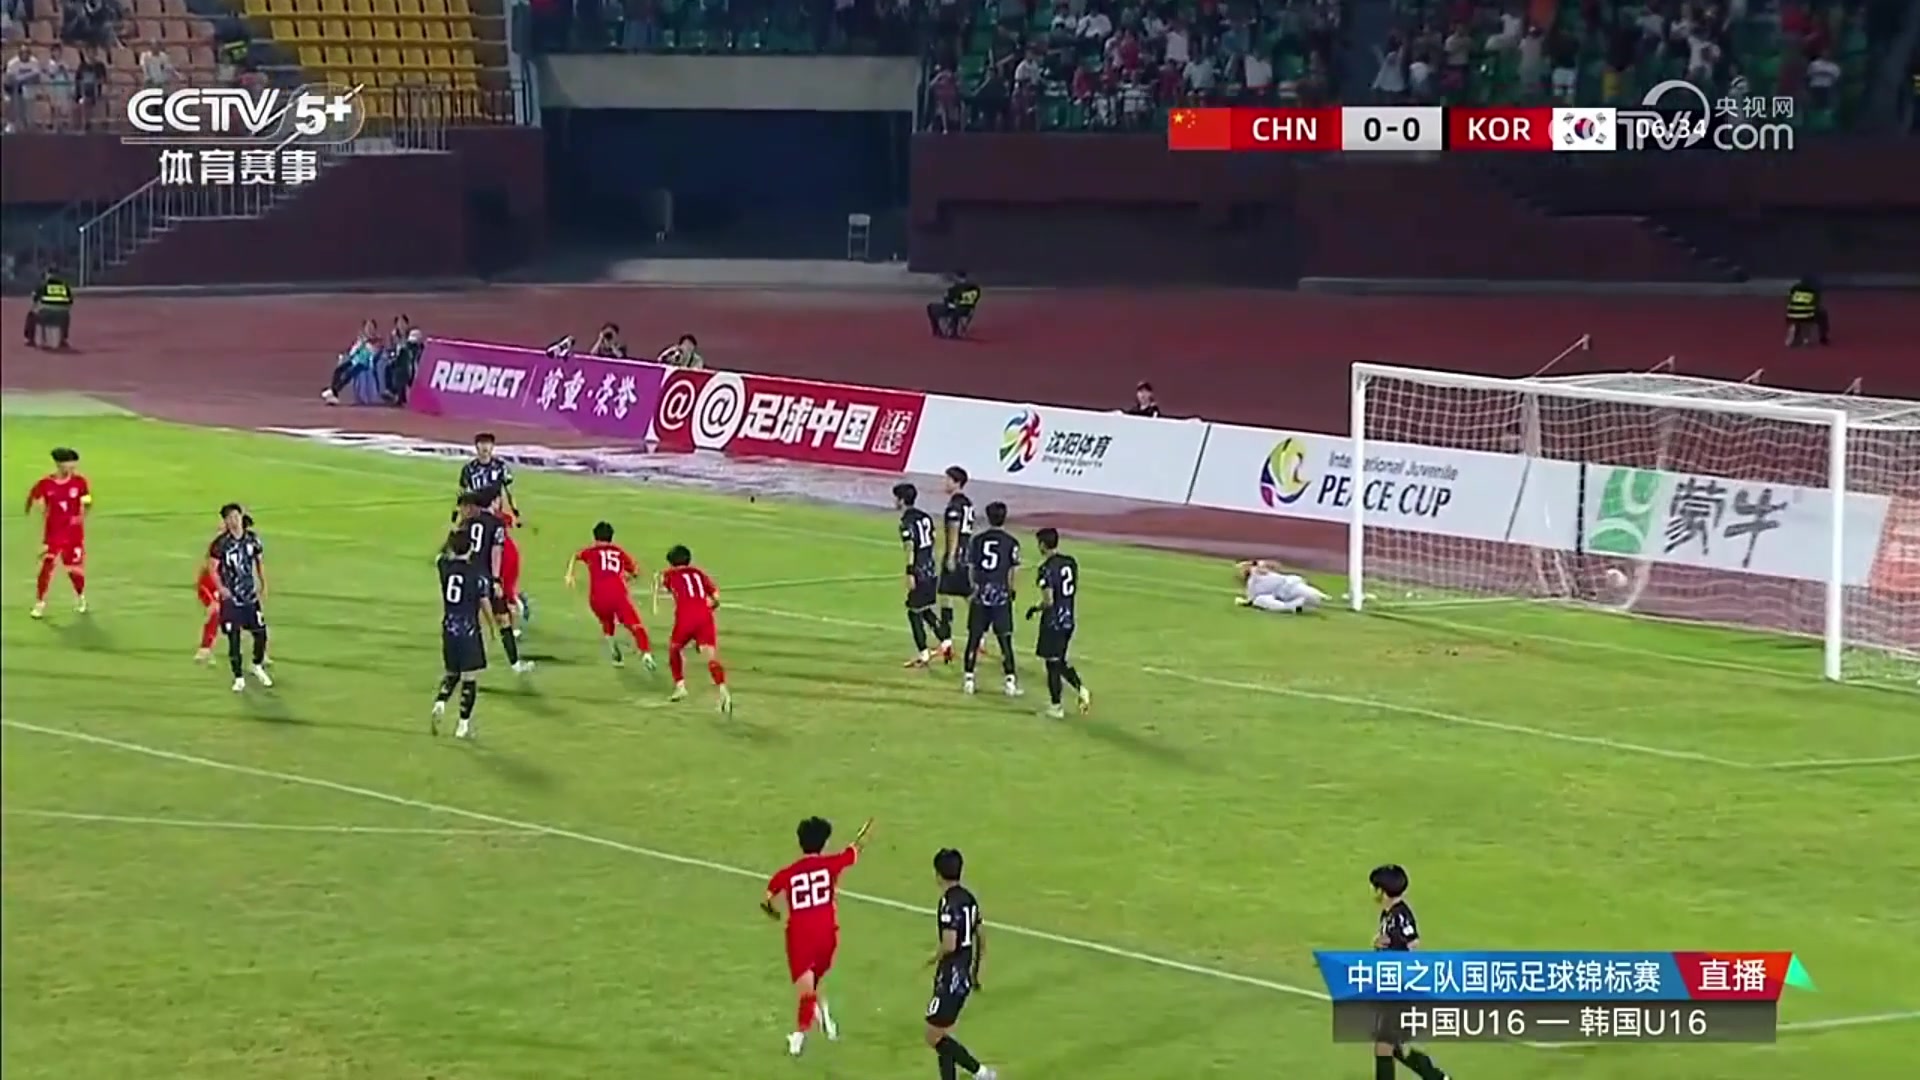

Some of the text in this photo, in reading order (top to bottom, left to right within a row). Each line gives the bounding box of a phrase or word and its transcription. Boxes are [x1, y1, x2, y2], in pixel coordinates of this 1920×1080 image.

[430, 360, 526, 398] RESPECT
[1045, 430, 1112, 459] 沈阳体育
[1329, 451, 1403, 474] Inteational
[1317, 474, 1452, 518] PECE CUP
[916, 517, 933, 549] 12
[1663, 477, 1788, 568] 蒙牛
[470, 523, 484, 552] 9
[599, 550, 621, 573] 15
[981, 541, 999, 569] 5
[446, 574, 464, 603] 6
[682, 573, 705, 599] 11
[1060, 566, 1075, 596] 2
[790, 868, 831, 910] 22
